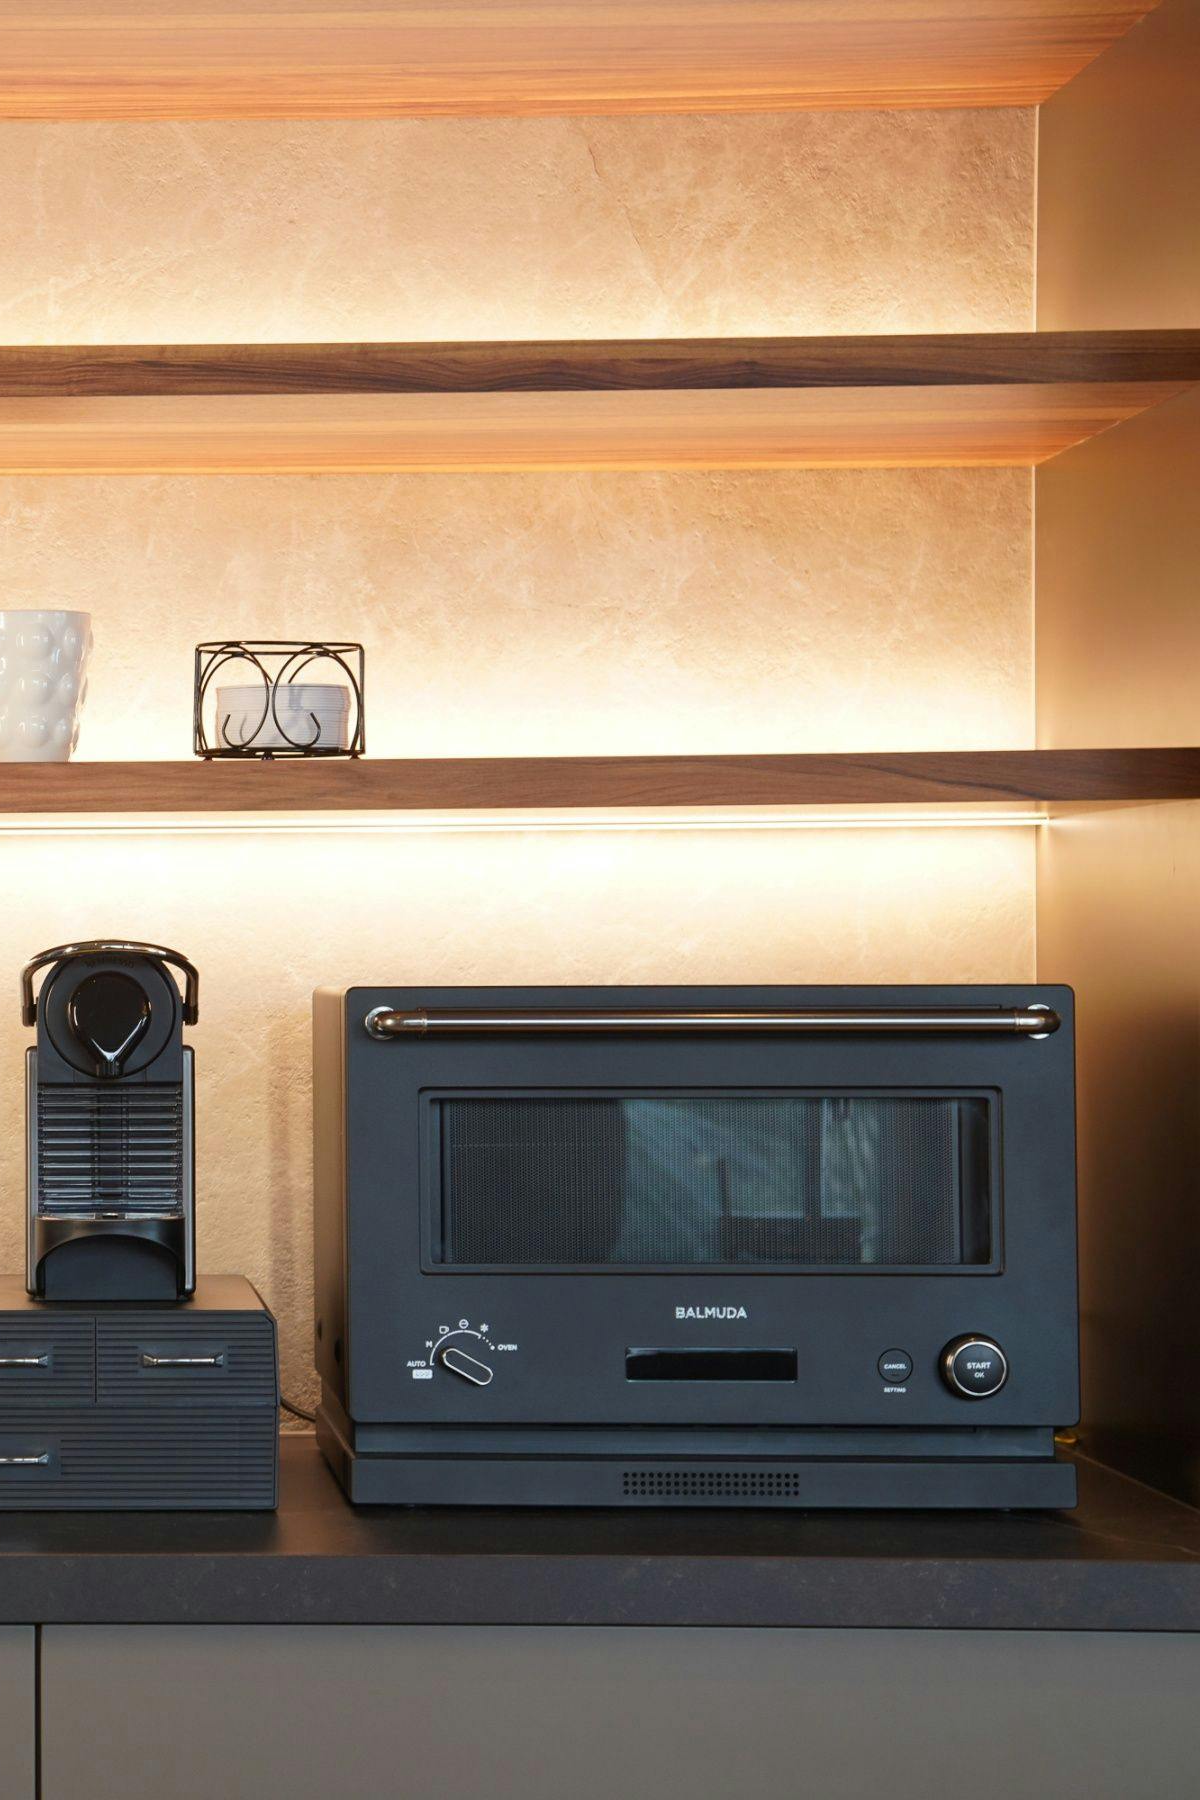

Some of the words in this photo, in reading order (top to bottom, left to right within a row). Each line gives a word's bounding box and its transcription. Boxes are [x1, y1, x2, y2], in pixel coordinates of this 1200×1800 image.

[675, 1306, 748, 1319] BALMUDA
[406, 1360, 426, 1368] AUTO
[966, 1361, 991, 1370] START
